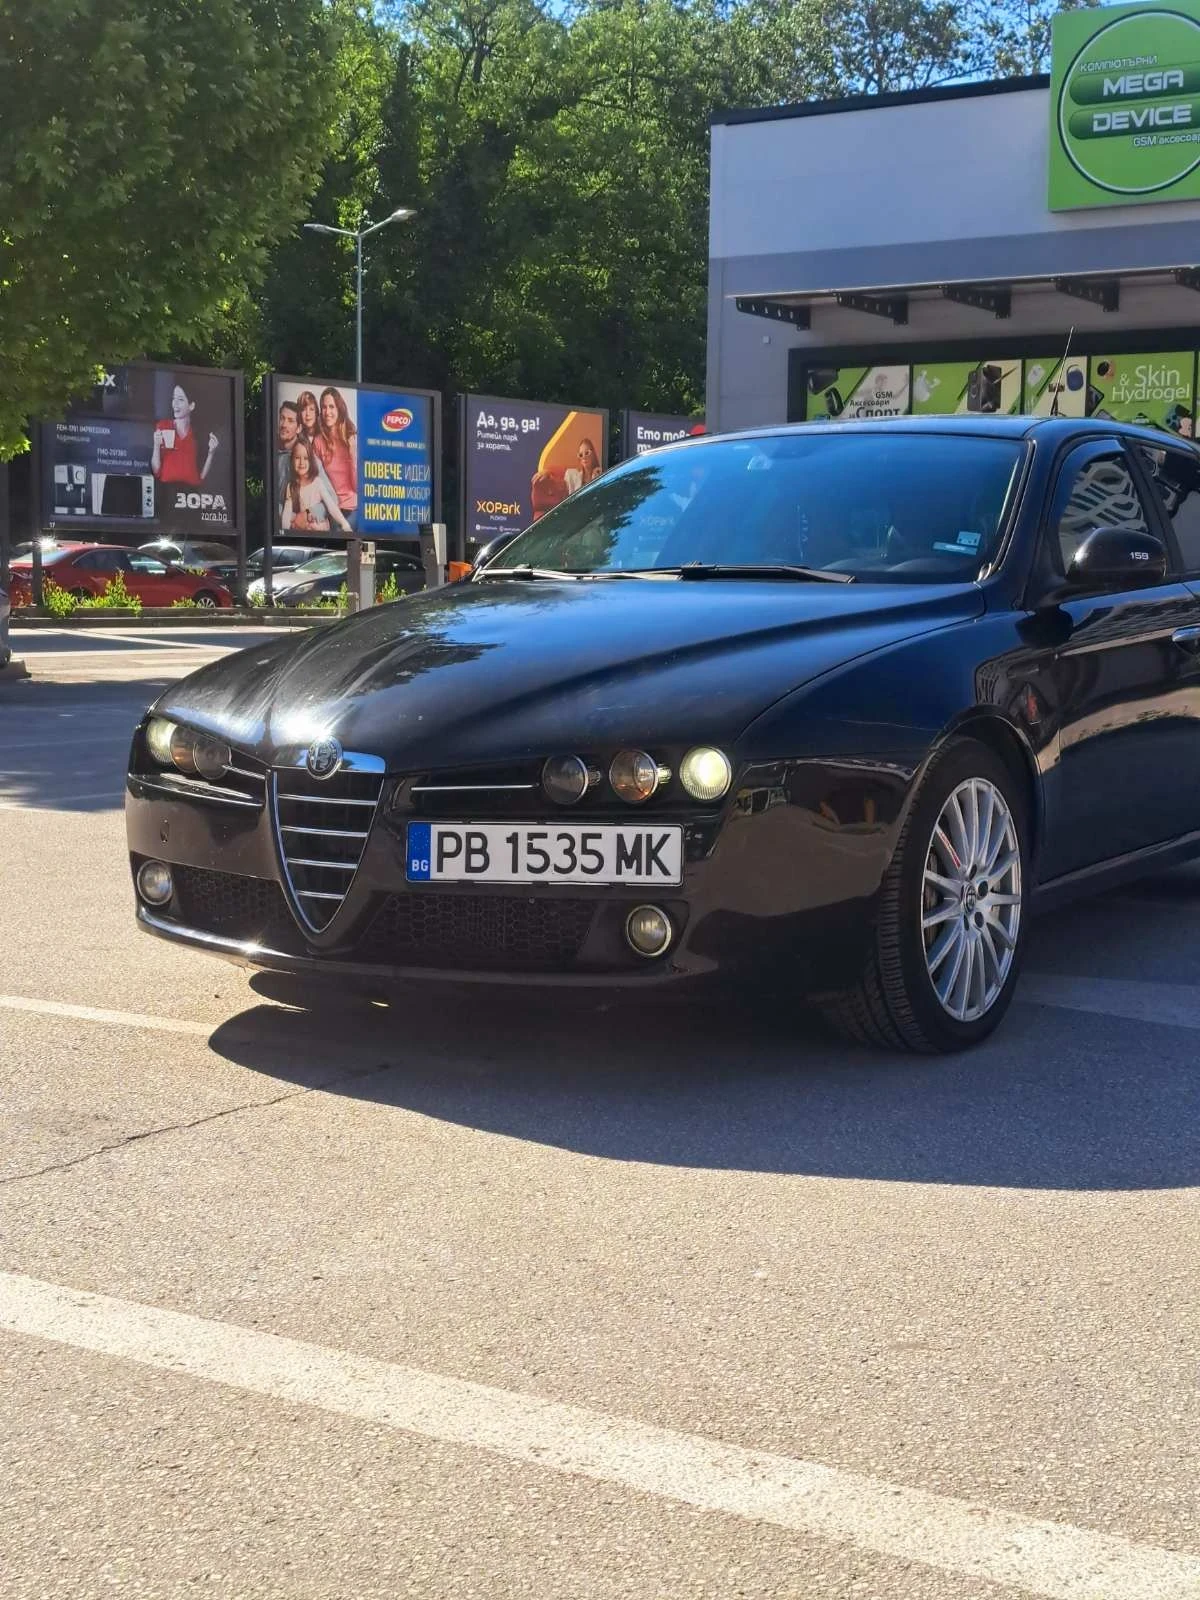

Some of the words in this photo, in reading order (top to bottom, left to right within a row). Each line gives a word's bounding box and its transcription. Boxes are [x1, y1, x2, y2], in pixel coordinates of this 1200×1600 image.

[1103, 69, 1184, 97] MEGA
[1092, 103, 1193, 132] DEVICE
[1133, 135, 1157, 147] GSM
[1120, 373, 1130, 386] &
[1135, 364, 1180, 387] Skin
[875, 391, 893, 399] GSM
[1112, 383, 1190, 404] Hydrogel
[386, 415, 409, 425] PEPCO
[637, 426, 660, 441] Ето
[364, 461, 402, 480] ПОВЕЧЕ
[404, 465, 431, 482] ИДЕИ
[364, 483, 405, 499] ПО-ГОЛЯМ
[406, 487, 431, 500] ИЗБОР
[174, 492, 227, 510] ЗОРА
[476, 500, 521, 515] XOPark
[364, 503, 400, 521] НИСКИ
[403, 505, 431, 524] ЦЕНИ
[1129, 551, 1149, 560] 159
[436, 831, 490, 873] PB
[506, 832, 605, 875] 1535
[615, 833, 672, 876] MK
[411, 859, 429, 872] BG
